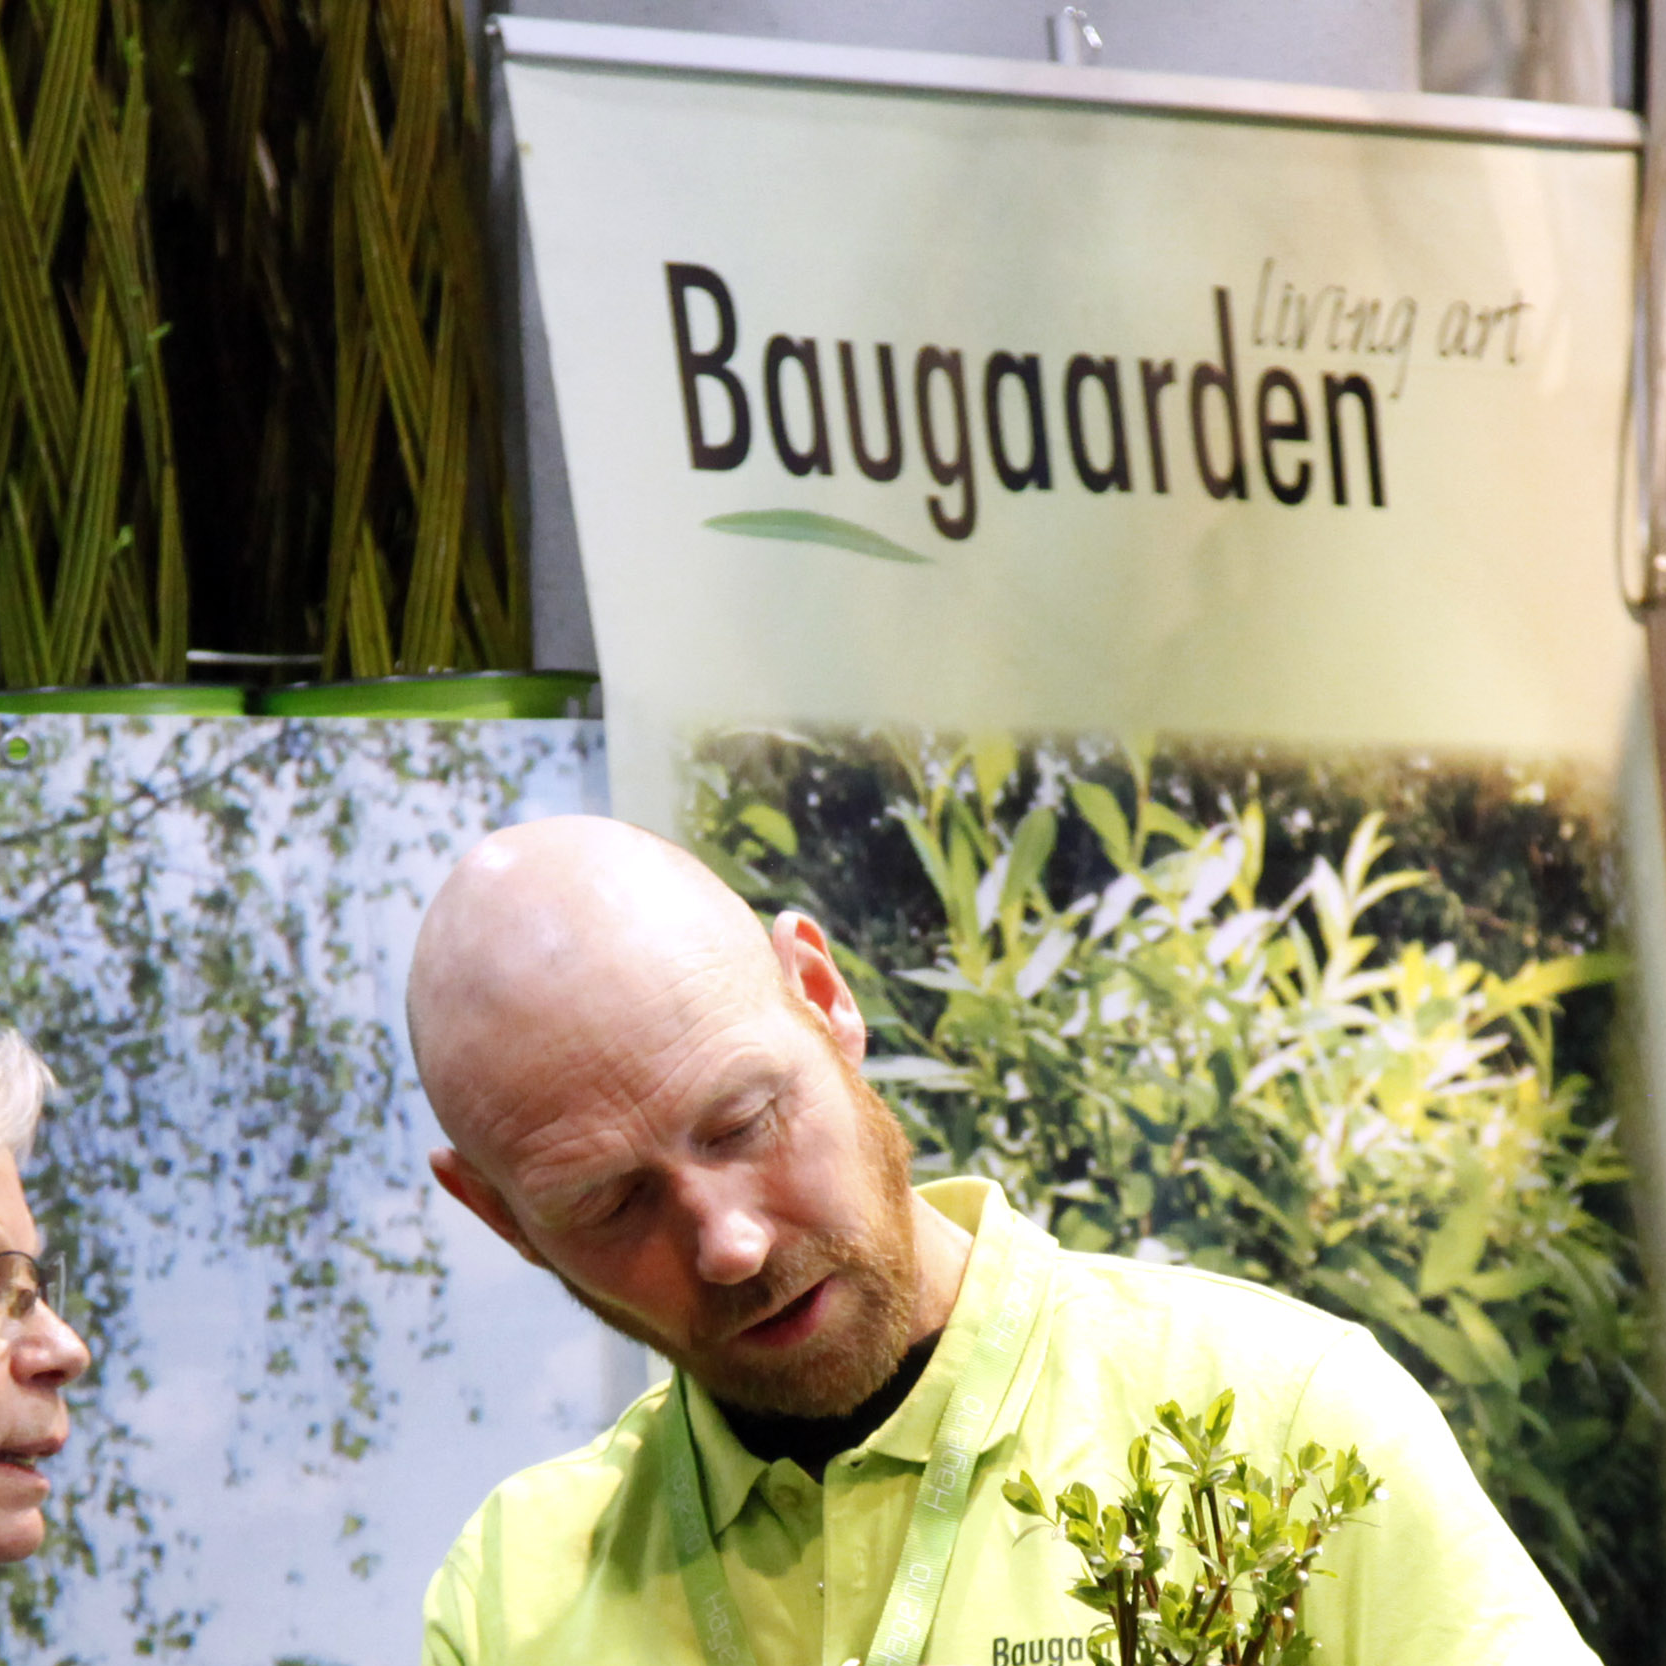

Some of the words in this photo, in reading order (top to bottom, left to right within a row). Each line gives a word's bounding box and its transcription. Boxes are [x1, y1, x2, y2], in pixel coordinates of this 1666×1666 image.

[664, 260, 1388, 542] Baugaarden
[1251, 257, 1419, 400] living
[1437, 288, 1535, 364] art
